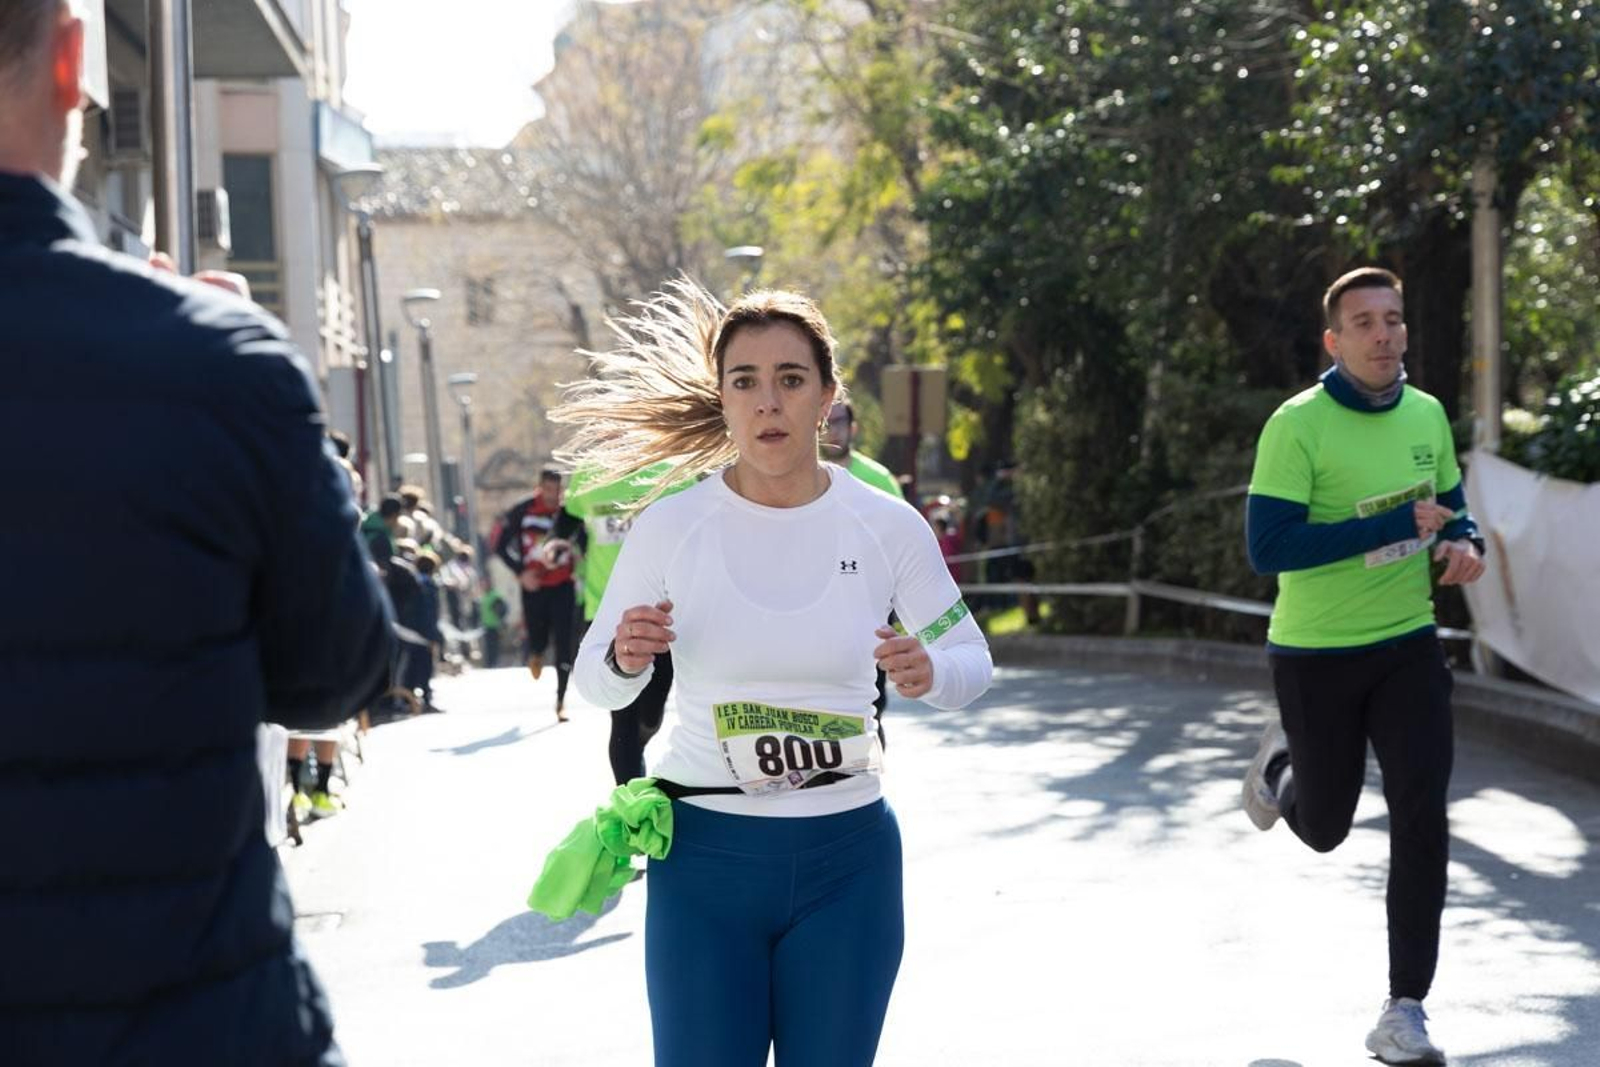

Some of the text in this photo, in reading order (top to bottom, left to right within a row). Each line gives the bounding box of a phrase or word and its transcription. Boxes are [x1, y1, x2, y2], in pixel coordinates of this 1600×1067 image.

[726, 715, 815, 734] IV CARRERA POPULAR
[743, 703, 762, 715] SAN
[764, 707, 789, 719] JUAN
[791, 711, 819, 726] BOSCO
[755, 735, 843, 776] 800
